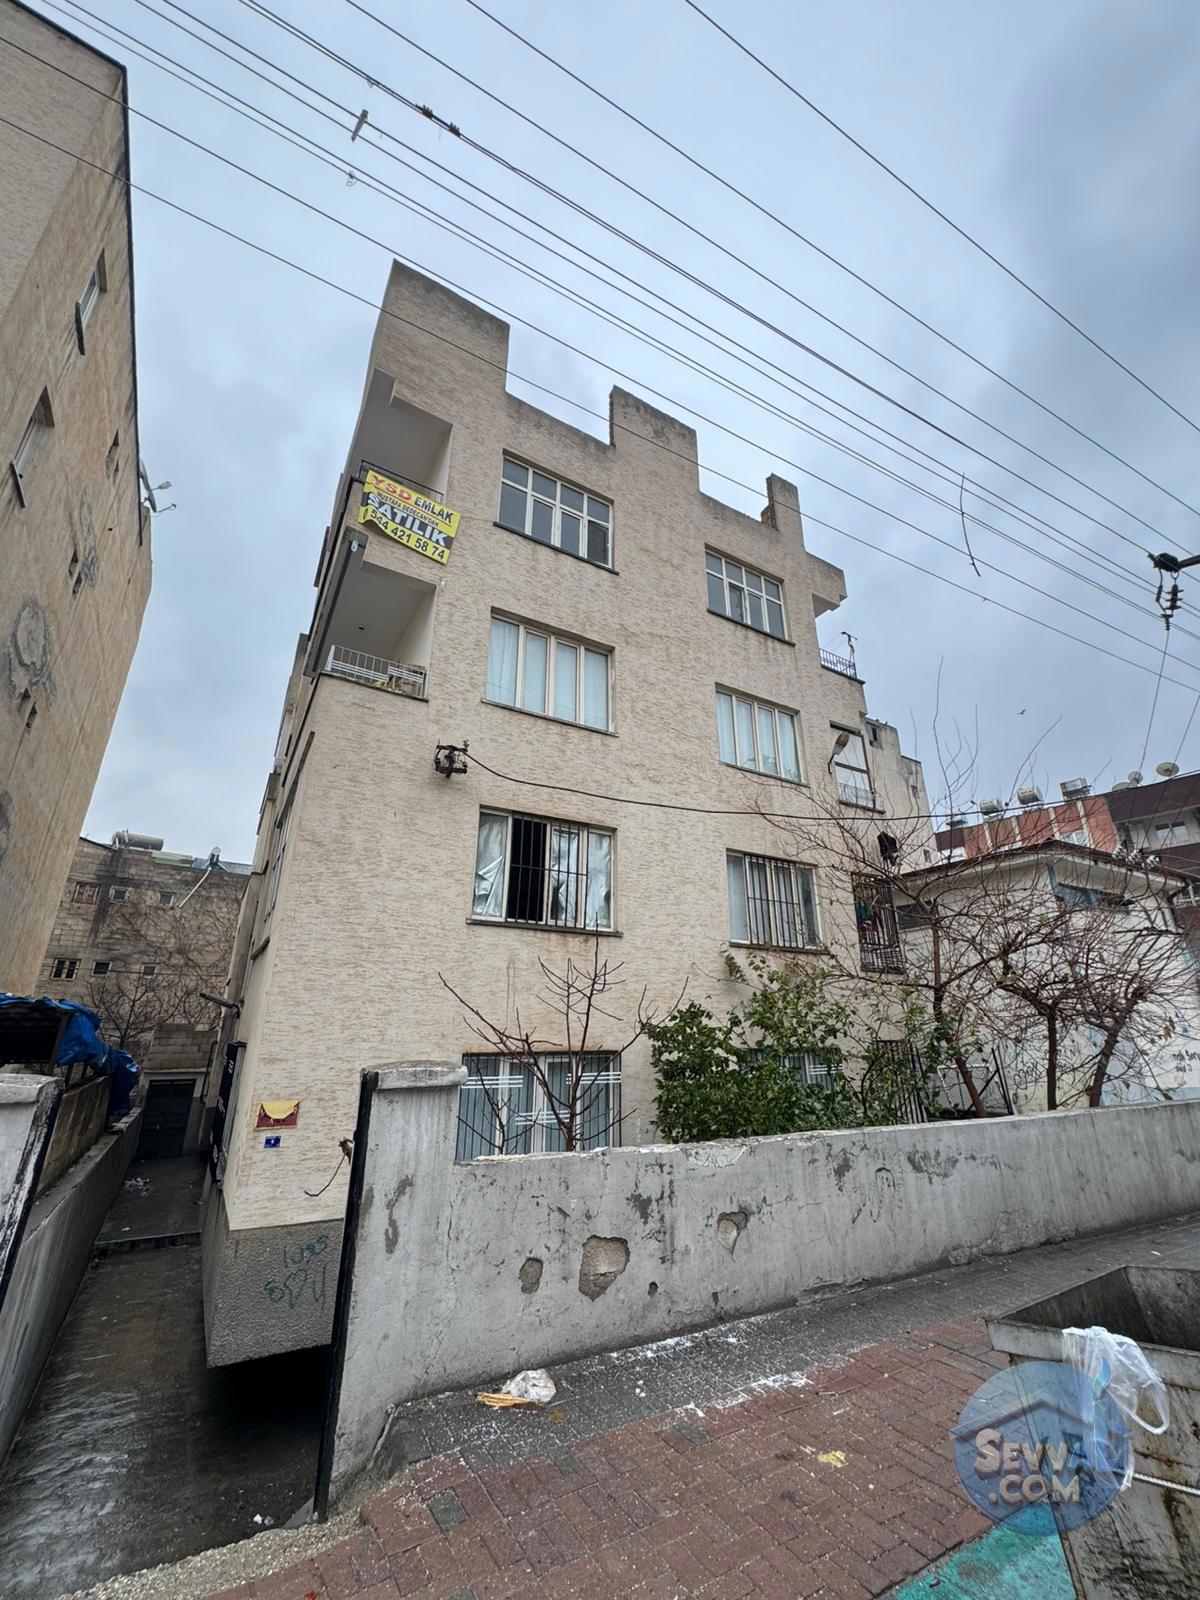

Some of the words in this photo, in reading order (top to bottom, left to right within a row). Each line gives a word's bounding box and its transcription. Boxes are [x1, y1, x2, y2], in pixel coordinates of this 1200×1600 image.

[367, 493, 449, 547] SATILIK
[371, 474, 412, 501] YSD
[414, 497, 454, 524] EMLAK
[391, 529, 412, 544] 421
[414, 537, 429, 552] 58
[431, 545, 445, 560] 74
